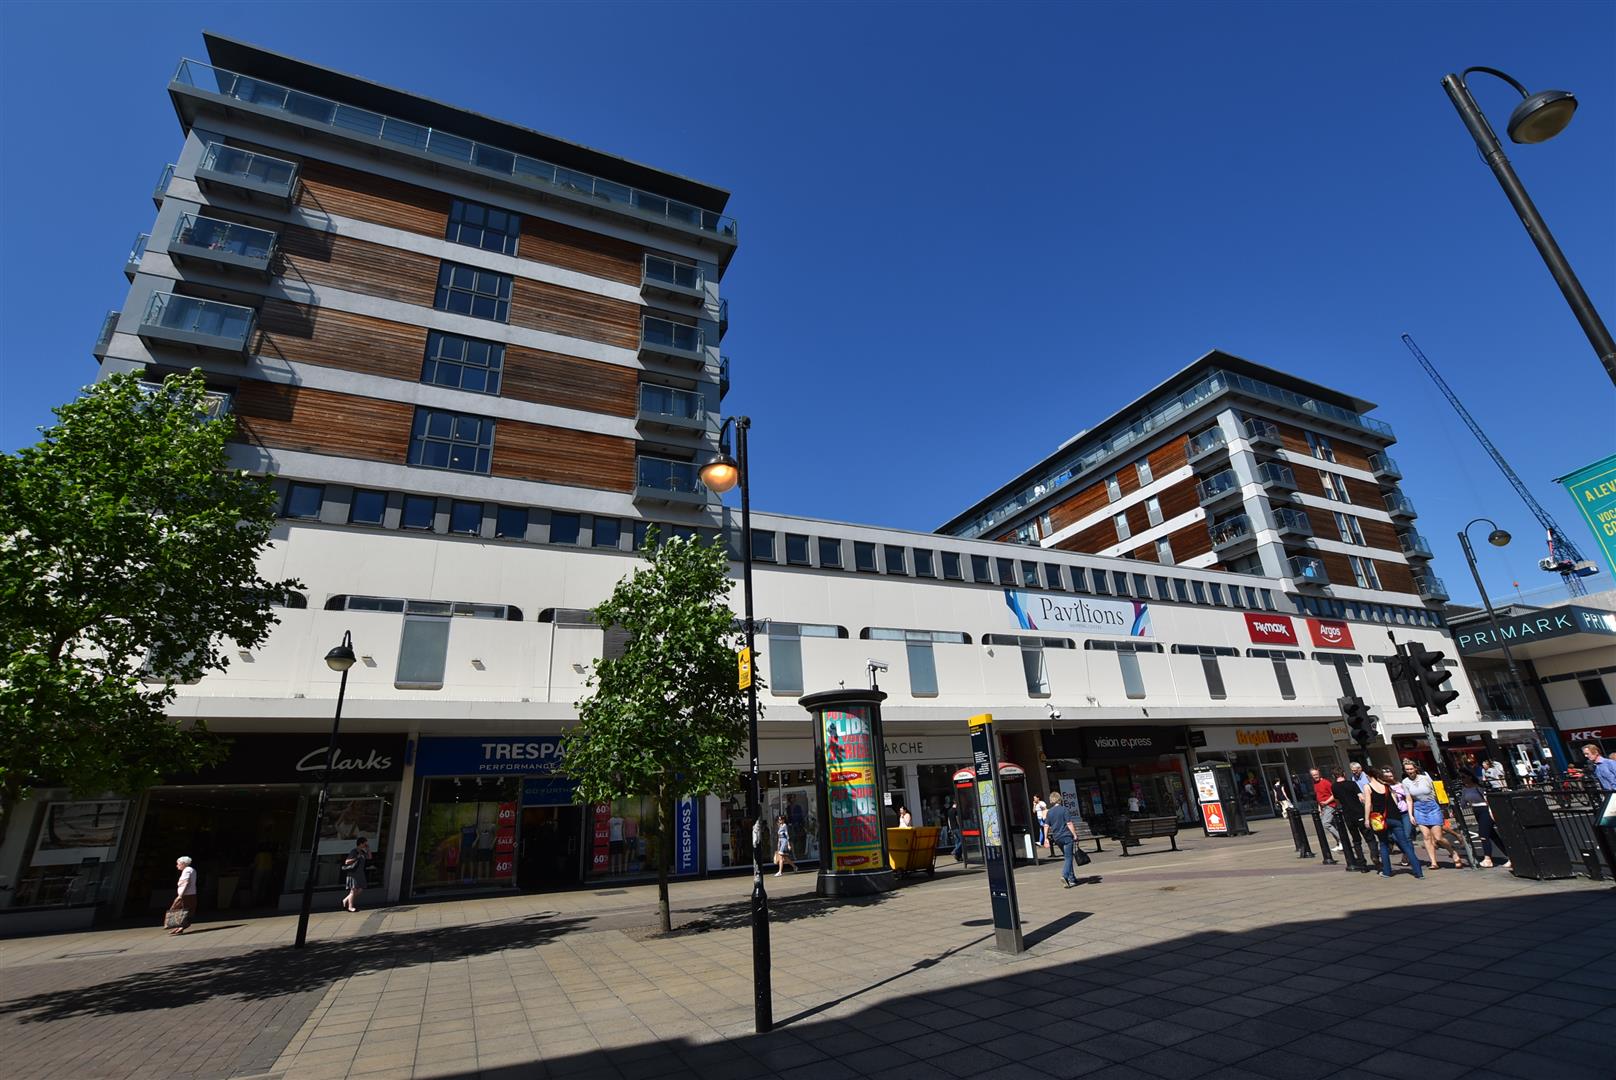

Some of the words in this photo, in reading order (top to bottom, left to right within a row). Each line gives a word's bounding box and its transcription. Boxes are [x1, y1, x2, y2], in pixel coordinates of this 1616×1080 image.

[1585, 490, 1597, 502] A
[1593, 479, 1616, 498] LEV
[1597, 508, 1616, 523] VOC
[1040, 597, 1125, 625] Pavilions
[1320, 624, 1341, 638] Argos
[1458, 614, 1573, 648] PRIMARK
[1093, 736, 1120, 748] vision
[1570, 730, 1602, 741] KFC
[296, 746, 392, 771] Clarks
[682, 808, 692, 870] TRESPASS
